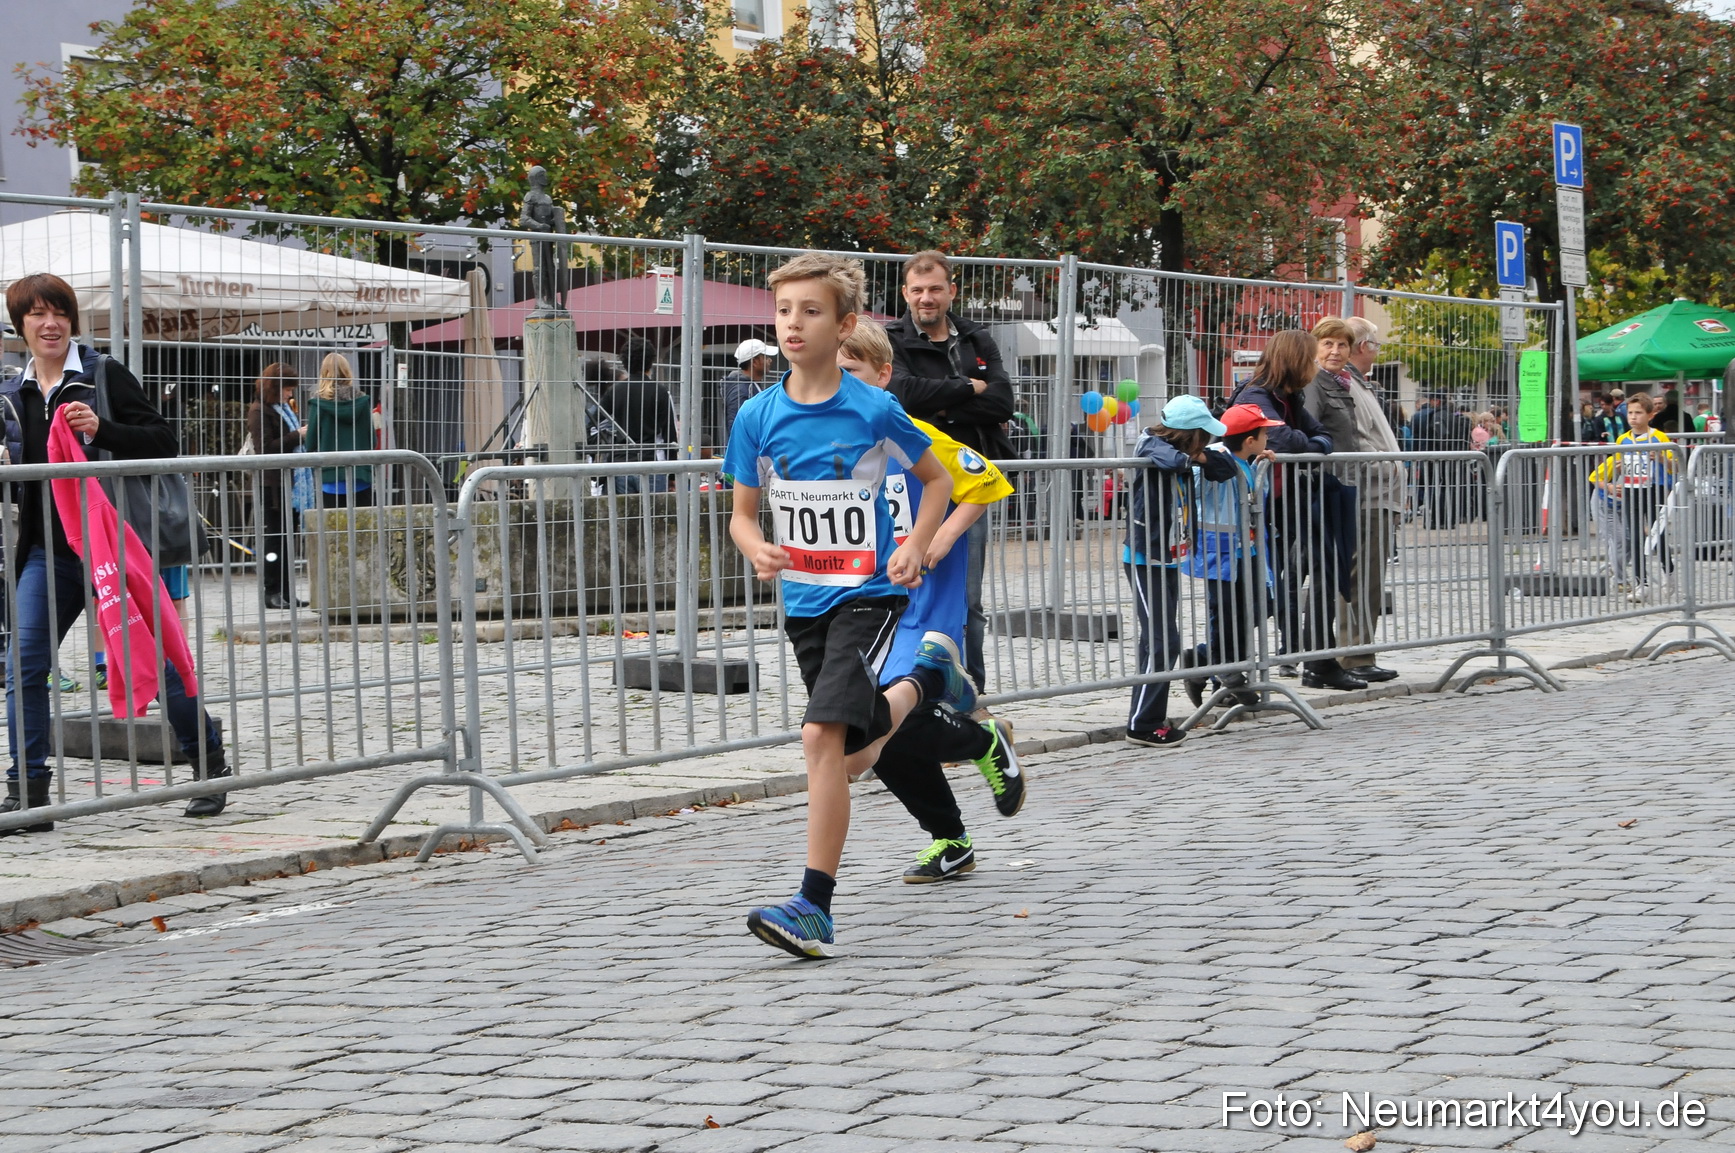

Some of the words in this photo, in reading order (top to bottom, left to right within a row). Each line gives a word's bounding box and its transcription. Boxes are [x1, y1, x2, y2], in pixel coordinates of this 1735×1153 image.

[1560, 132, 1576, 177] P
[1502, 231, 1518, 277] P
[176, 274, 254, 297] Tucher
[355, 281, 421, 303] Tucher
[334, 324, 375, 340] PIZZA
[770, 489, 799, 501] PARTL
[801, 491, 854, 501] Neumarkt
[779, 505, 866, 546] 7010
[803, 554, 845, 571] Moritz
